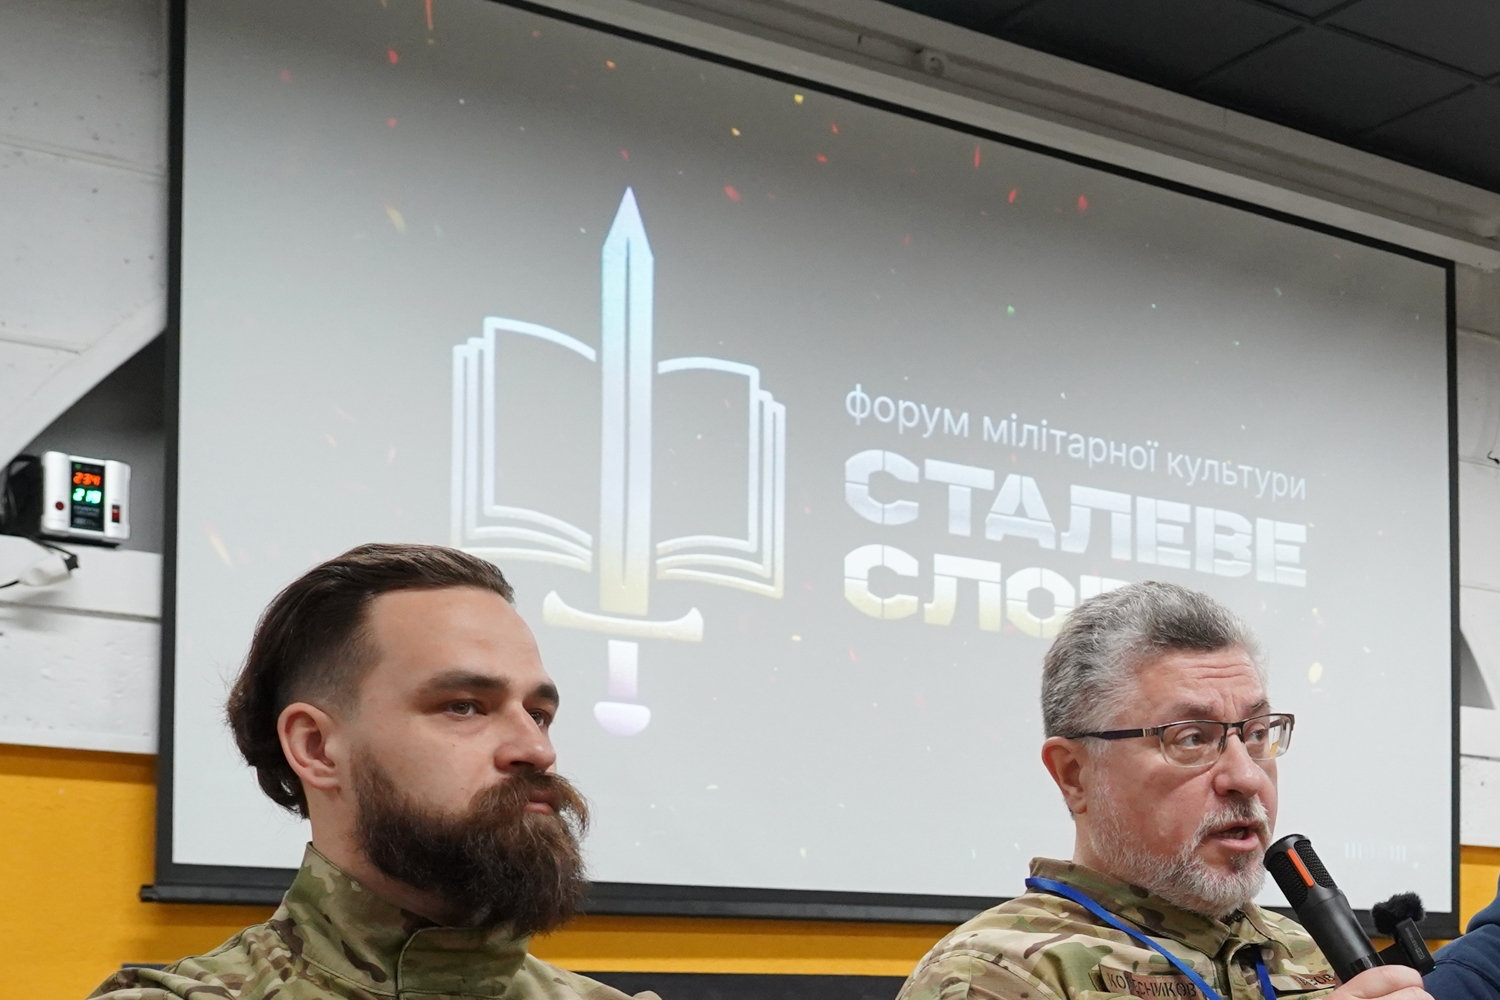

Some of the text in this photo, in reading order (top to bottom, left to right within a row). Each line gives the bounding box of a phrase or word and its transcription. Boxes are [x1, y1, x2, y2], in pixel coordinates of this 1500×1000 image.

[846, 383, 1306, 502] форум мілітарної культури
[845, 449, 1306, 587] СТАЛЕВЕ
[844, 544, 1130, 639] СЛО
